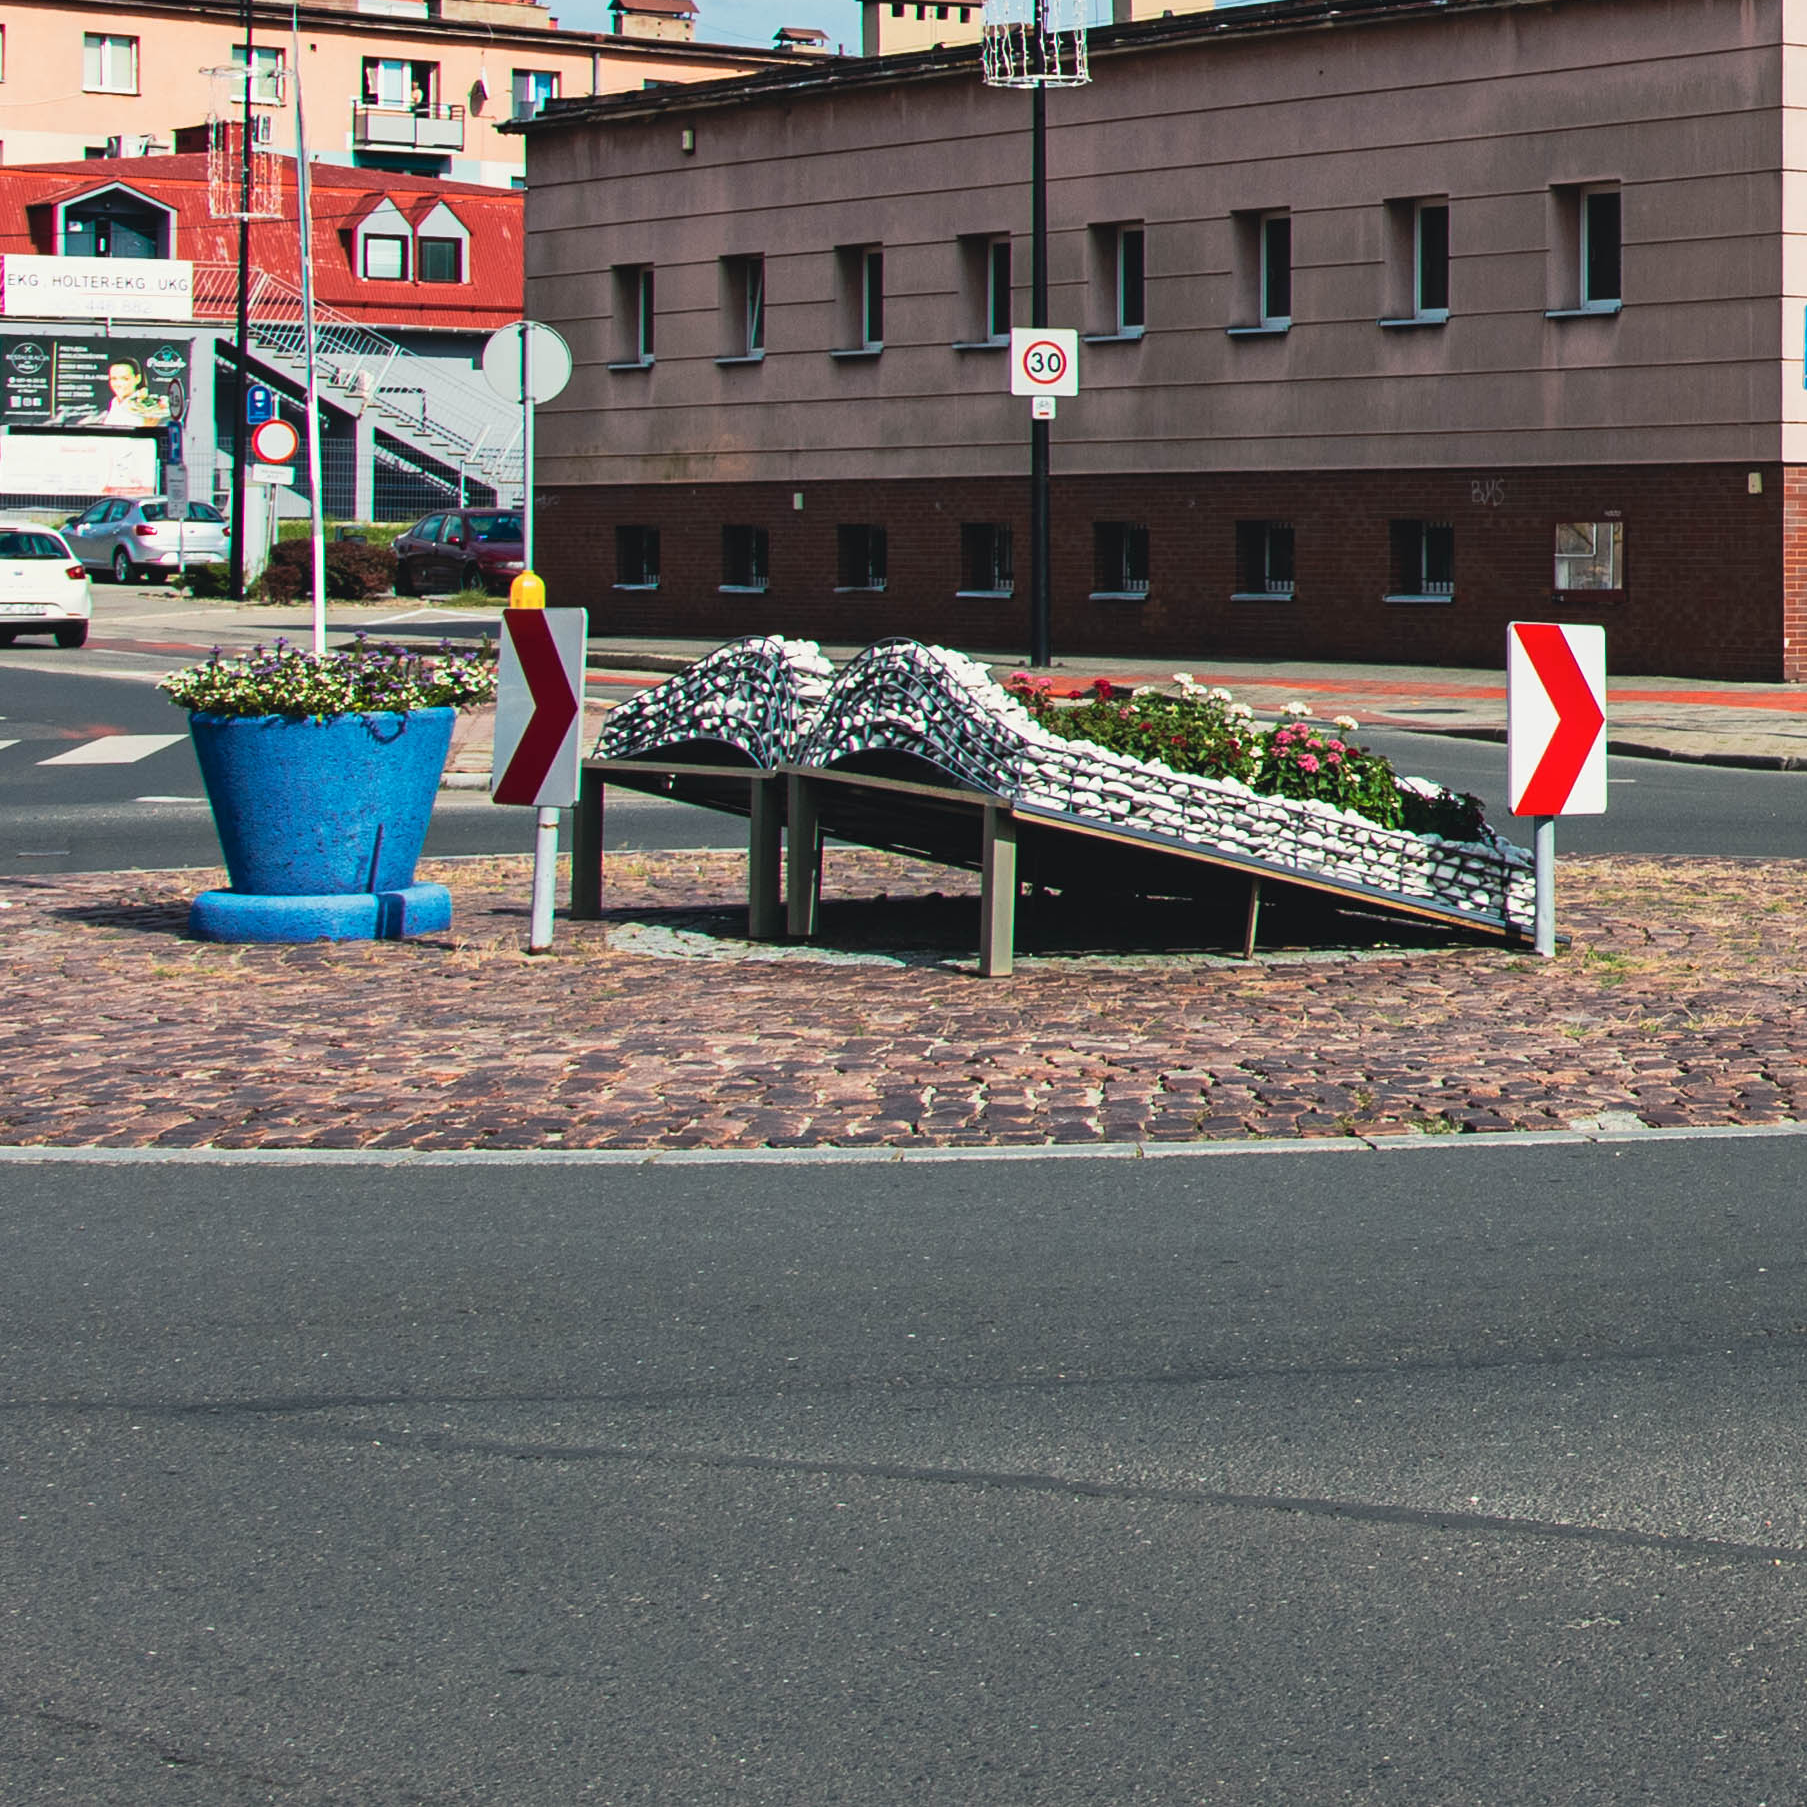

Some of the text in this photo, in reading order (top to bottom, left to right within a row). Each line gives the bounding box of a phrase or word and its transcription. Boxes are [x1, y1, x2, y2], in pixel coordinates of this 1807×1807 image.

[7, 273, 189, 292] EKG HOLTER-EKG UKG
[1031, 352, 1061, 372] 30
